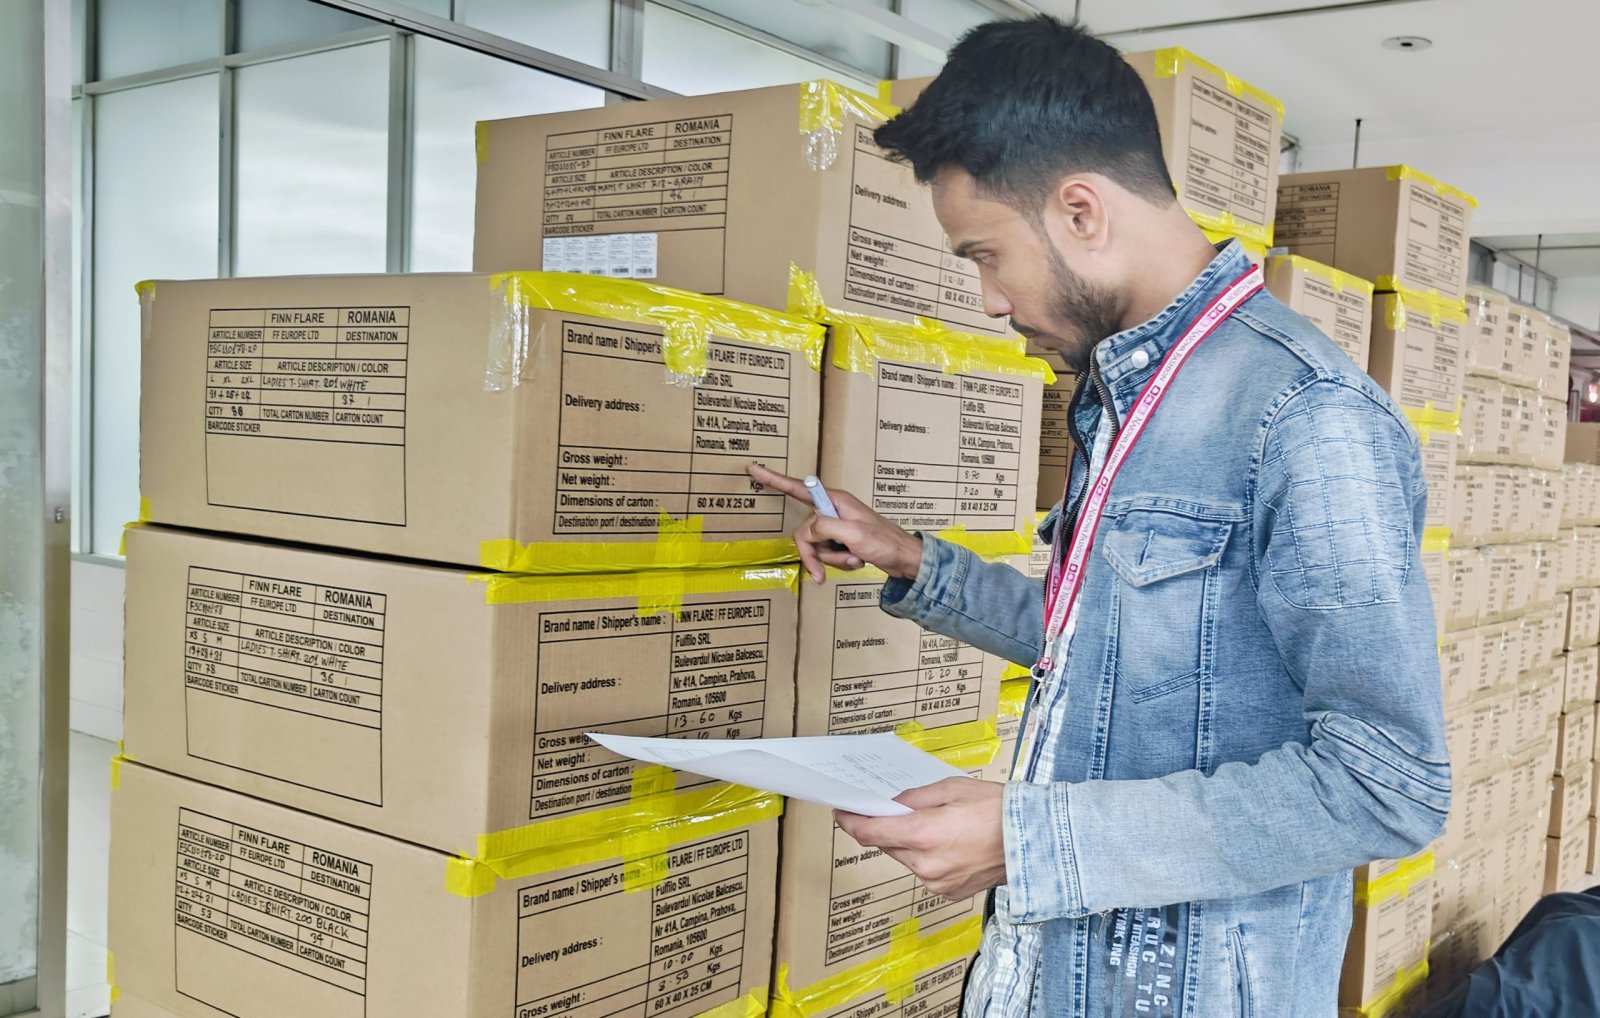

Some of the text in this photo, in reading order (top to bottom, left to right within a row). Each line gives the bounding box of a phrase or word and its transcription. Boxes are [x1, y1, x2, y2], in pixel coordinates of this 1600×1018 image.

[675, 119, 720, 133] ROMANIA
[604, 128, 653, 141] FINN FLARE
[673, 136, 721, 148] DESTINATION
[610, 162, 712, 178] ARTICLE DESCRIPTION COLOR
[855, 184, 907, 209] Delivery address
[664, 204, 707, 215] CARTON COUNT
[544, 225, 594, 234] BARCODE STICKER
[852, 231, 894, 251] Gross weight
[271, 313, 324, 323] FINN FLARE
[348, 311, 396, 323] ROMANIA
[212, 330, 261, 339] ARTICLE NUMBER
[273, 331, 319, 339] FF EUROPE LTD
[346, 332, 397, 341] DESTINATION
[568, 329, 661, 354] Brand name Shipper's
[277, 362, 389, 373] ARTICLE DESCRIPTION COLOR
[714, 350, 784, 370] FLARE FF EUROPE LTD
[340, 380, 368, 391] WHITE
[565, 394, 639, 413] Delivery address
[263, 408, 329, 421] TOTAL CARTON NUMBER
[336, 413, 384, 424] CARTON COUNT
[208, 421, 260, 432] BARCODE STICKER
[880, 420, 926, 434] Delivery address
[562, 452, 622, 467] Gross weight
[877, 465, 915, 478] Gross weight
[560, 495, 654, 507] Dimensions of carton
[698, 498, 755, 509] 60 X 40 X 25 CM
[875, 500, 933, 509] Dimensions of carton
[249, 580, 302, 597] FINN FLARE
[325, 590, 372, 609] ROMANIA
[323, 610, 374, 626] DESTINATION
[693, 605, 764, 621] FLARE FF EUROPE LTD
[544, 614, 662, 633] Brand name Shipper's name
[255, 629, 365, 656] ARTICLE DESCRIPTION COLOR
[698, 632, 711, 644] SRL
[837, 638, 885, 649] Delivery address
[321, 656, 349, 671] WHITE
[675, 651, 709, 668] Bulevardul
[711, 648, 734, 663] Nicolae
[187, 675, 239, 694] BARCODE STICKER
[241, 672, 307, 693] TOTAL CARTON NUMBER
[320, 672, 333, 684] 36
[674, 675, 682, 688] Nr
[834, 679, 873, 692] Gross weight
[541, 677, 616, 696] Delivery address
[313, 687, 360, 704] CARTON COUNT
[672, 691, 727, 709] Romania, 105600
[729, 708, 742, 720] Kgs
[238, 830, 290, 854] FINN FLARE
[312, 852, 359, 877] ROMANIA
[835, 855, 858, 868] Delivery
[311, 871, 360, 894] DESTINATION
[523, 873, 618, 908] Brand name Shipper's
[244, 879, 351, 922] ARTICLE DESCRIPTION COLOR
[201, 908, 212, 918] 53
[831, 912, 862, 927] Net weight
[177, 914, 227, 940] BARCODE STICKER
[296, 912, 312, 924] 200
[316, 919, 349, 938] BLACK
[830, 918, 890, 943] Dimensions of carton
[230, 919, 294, 950] TOTAL CARTON NUMBER
[1142, 908, 1161, 963] RUC
[300, 945, 345, 968] CARTON COUNT
[522, 938, 597, 968] Delivery address
[710, 943, 723, 956] Kgs
[1154, 943, 1176, 1007] ZINC
